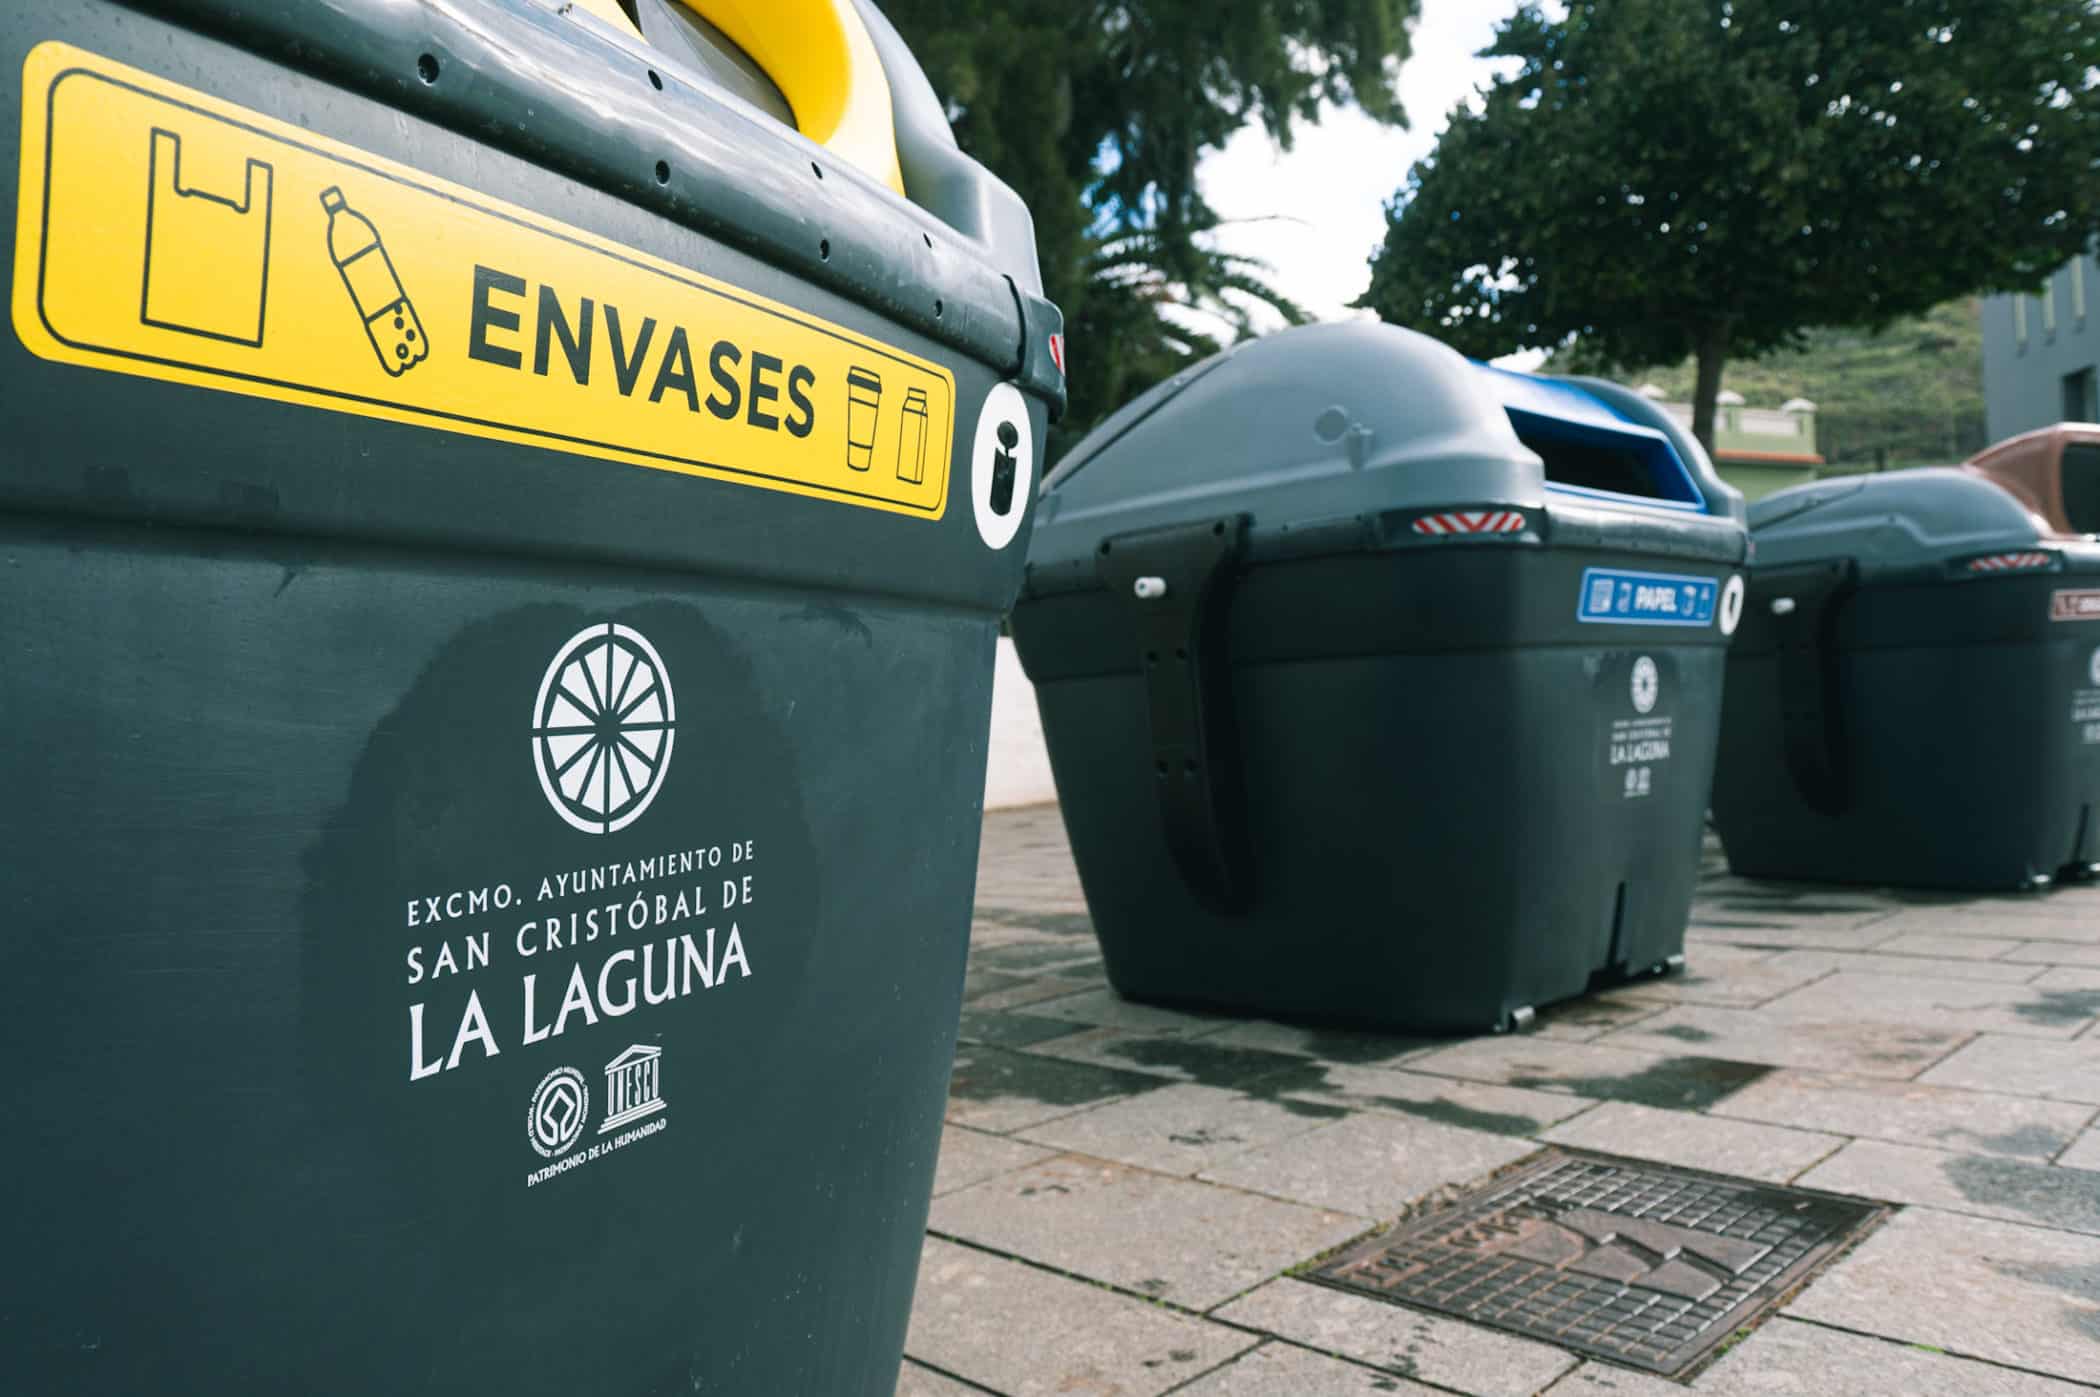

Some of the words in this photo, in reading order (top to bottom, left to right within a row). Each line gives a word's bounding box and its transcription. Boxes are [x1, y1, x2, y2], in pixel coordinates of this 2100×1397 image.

[468, 264, 816, 439] ENVASES
[1635, 586, 1677, 612] PAPEL
[407, 884, 522, 927] EXCMO.
[537, 846, 722, 902] AYUNTAMIENTO
[732, 840, 753, 863] DE
[407, 932, 490, 985] SAN
[516, 886, 707, 957] CRISTÓBAL
[722, 875, 753, 909] DE
[409, 989, 501, 1081] LA
[522, 922, 752, 1046] LAGUNA
[607, 1057, 659, 1117] UNESCO
[527, 1151, 587, 1188] PATRIMONIO
[588, 1144, 601, 1161] DE
[601, 1140, 614, 1155] LA
[614, 1117, 667, 1150] HUMANIDAD
